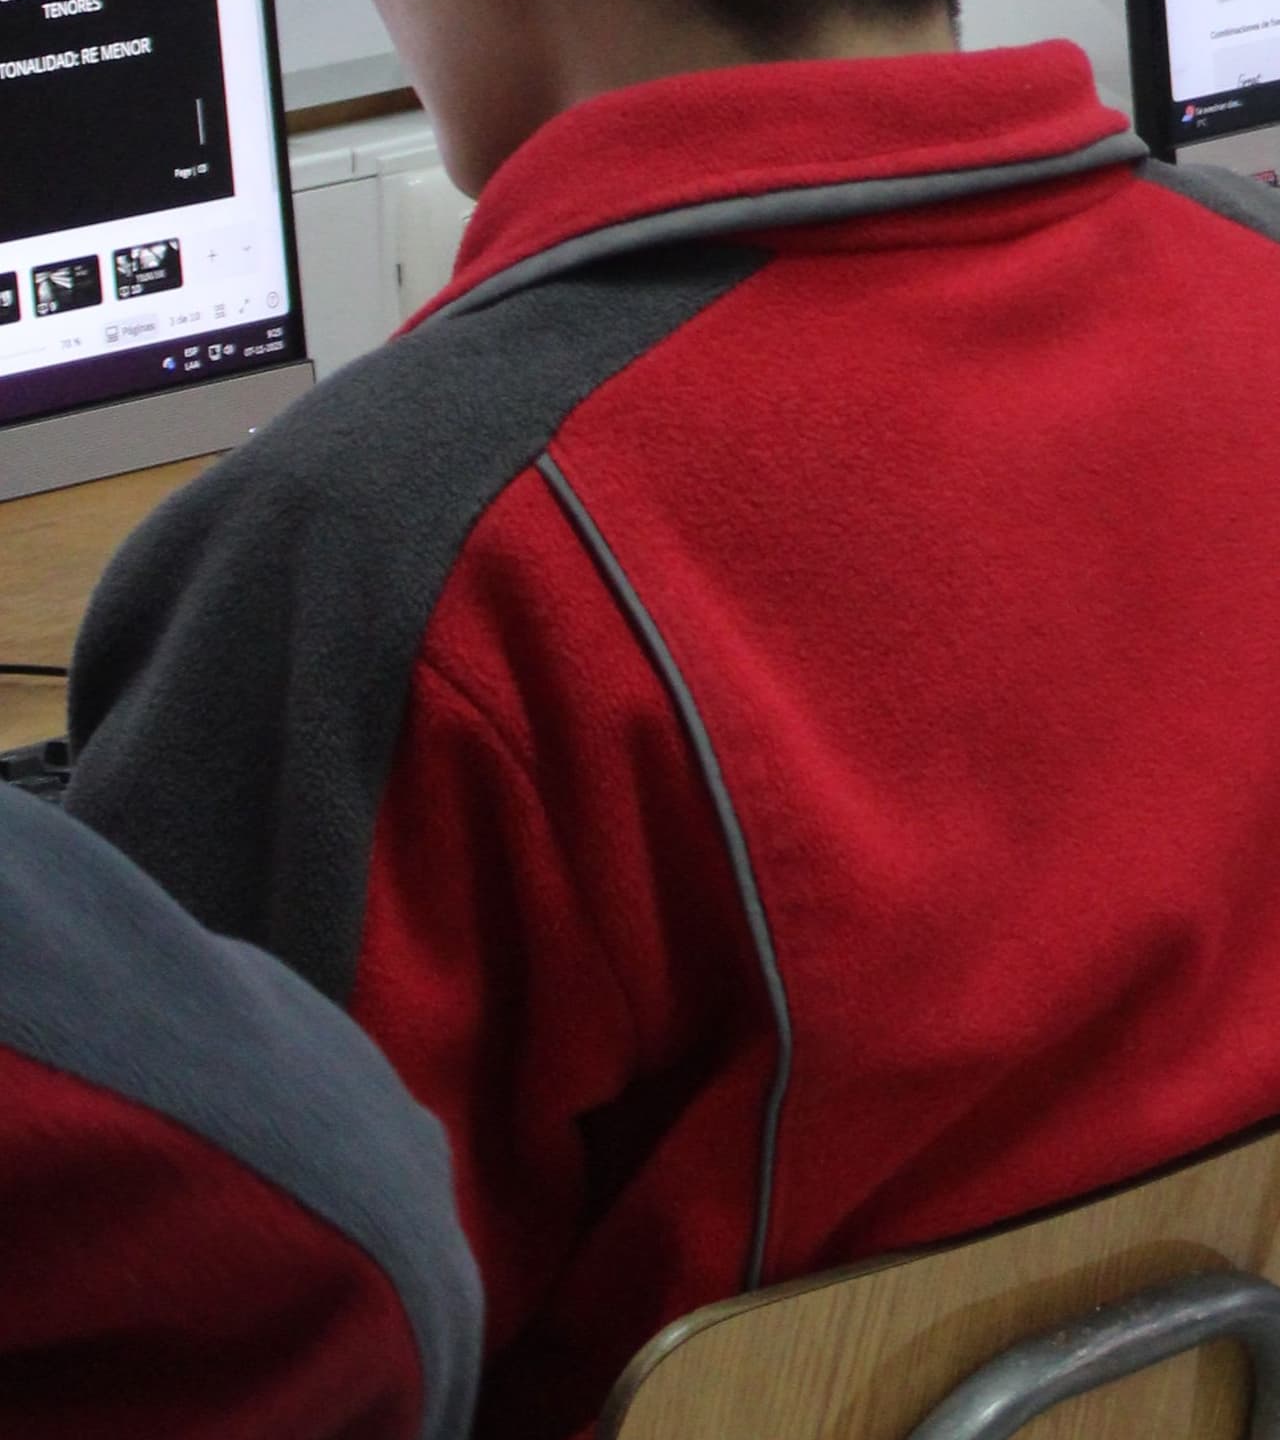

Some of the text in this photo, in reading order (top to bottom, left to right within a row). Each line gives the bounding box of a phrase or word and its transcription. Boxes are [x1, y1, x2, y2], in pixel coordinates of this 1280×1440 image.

[1210, 22, 1259, 40] Combinaciones
[1261, 20, 1269, 29] de
[0, 37, 151, 80] TONALIDAD: RE MENOR
[122, 322, 156, 338] Páginas
